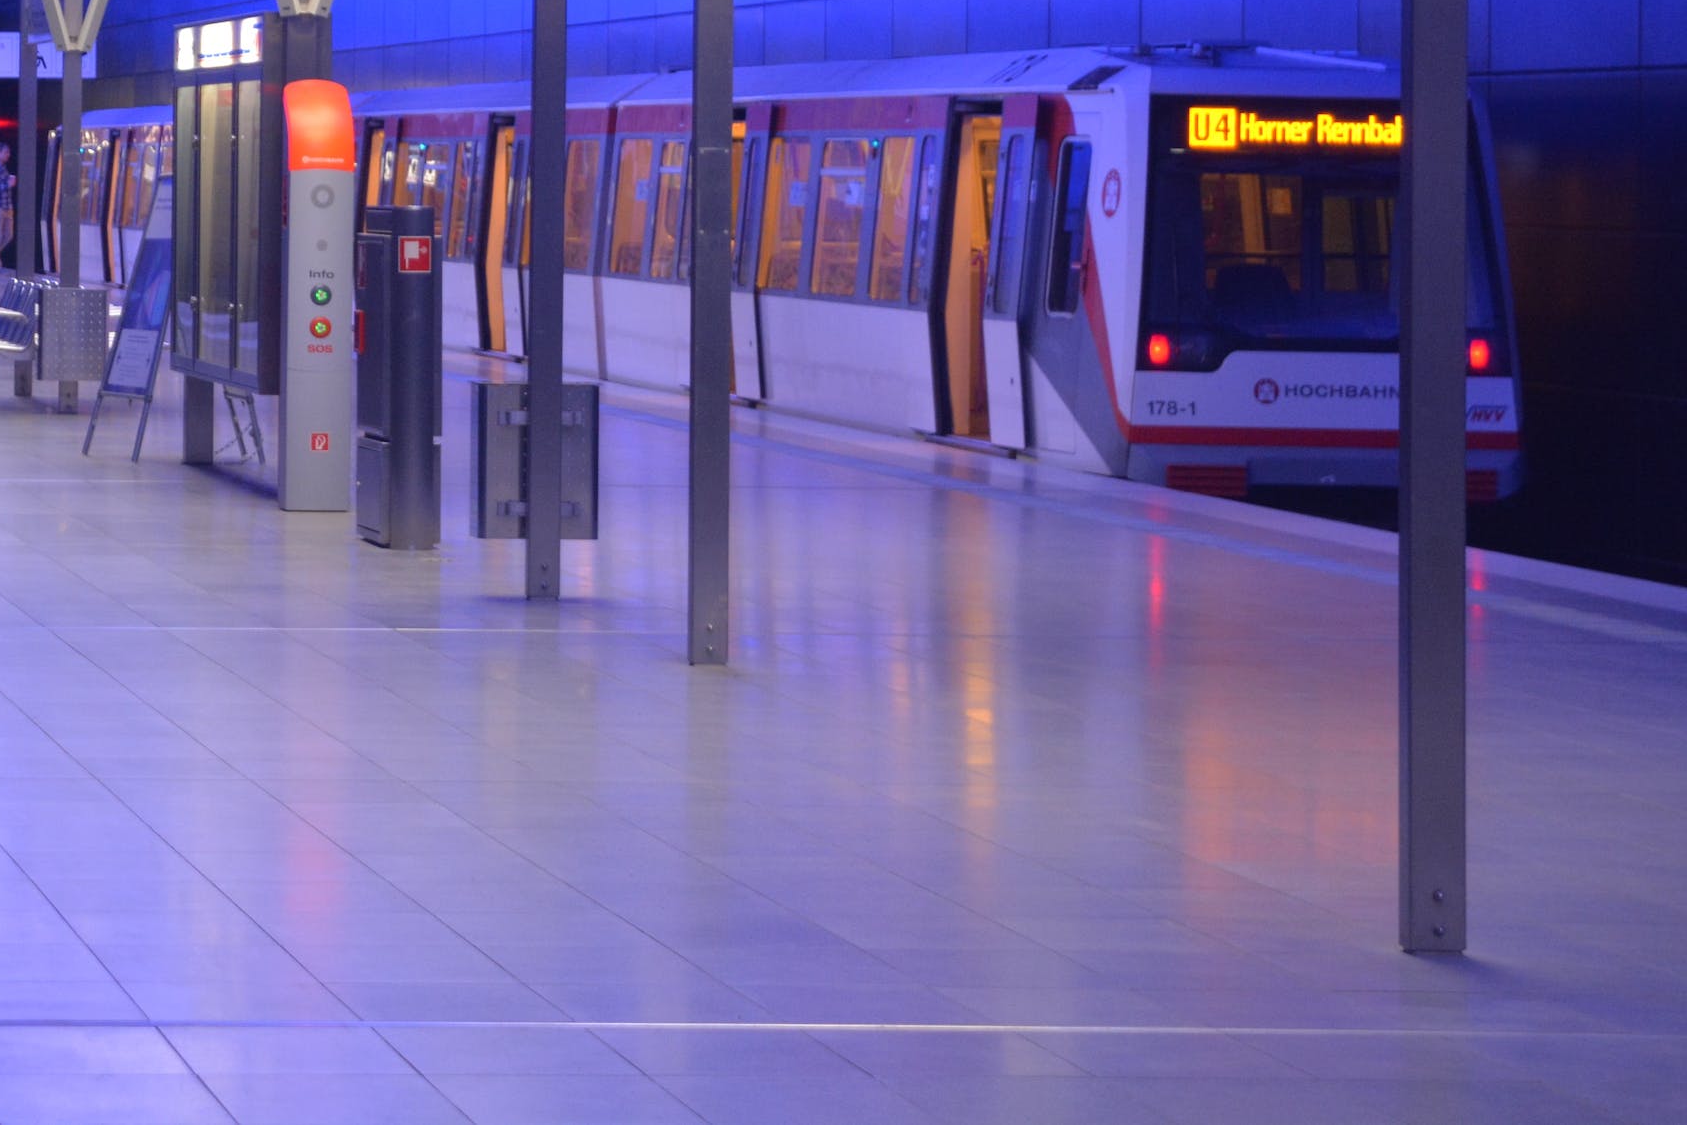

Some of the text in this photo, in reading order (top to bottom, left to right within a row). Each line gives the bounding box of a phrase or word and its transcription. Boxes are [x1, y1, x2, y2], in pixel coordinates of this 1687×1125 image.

[1194, 112, 1231, 141] U4
[1240, 113, 1312, 142] Horner
[309, 269, 335, 279] Info
[307, 344, 333, 353] SOS
[1284, 384, 1400, 399] HOCHBAHN
[1147, 401, 1197, 416] 178-1
